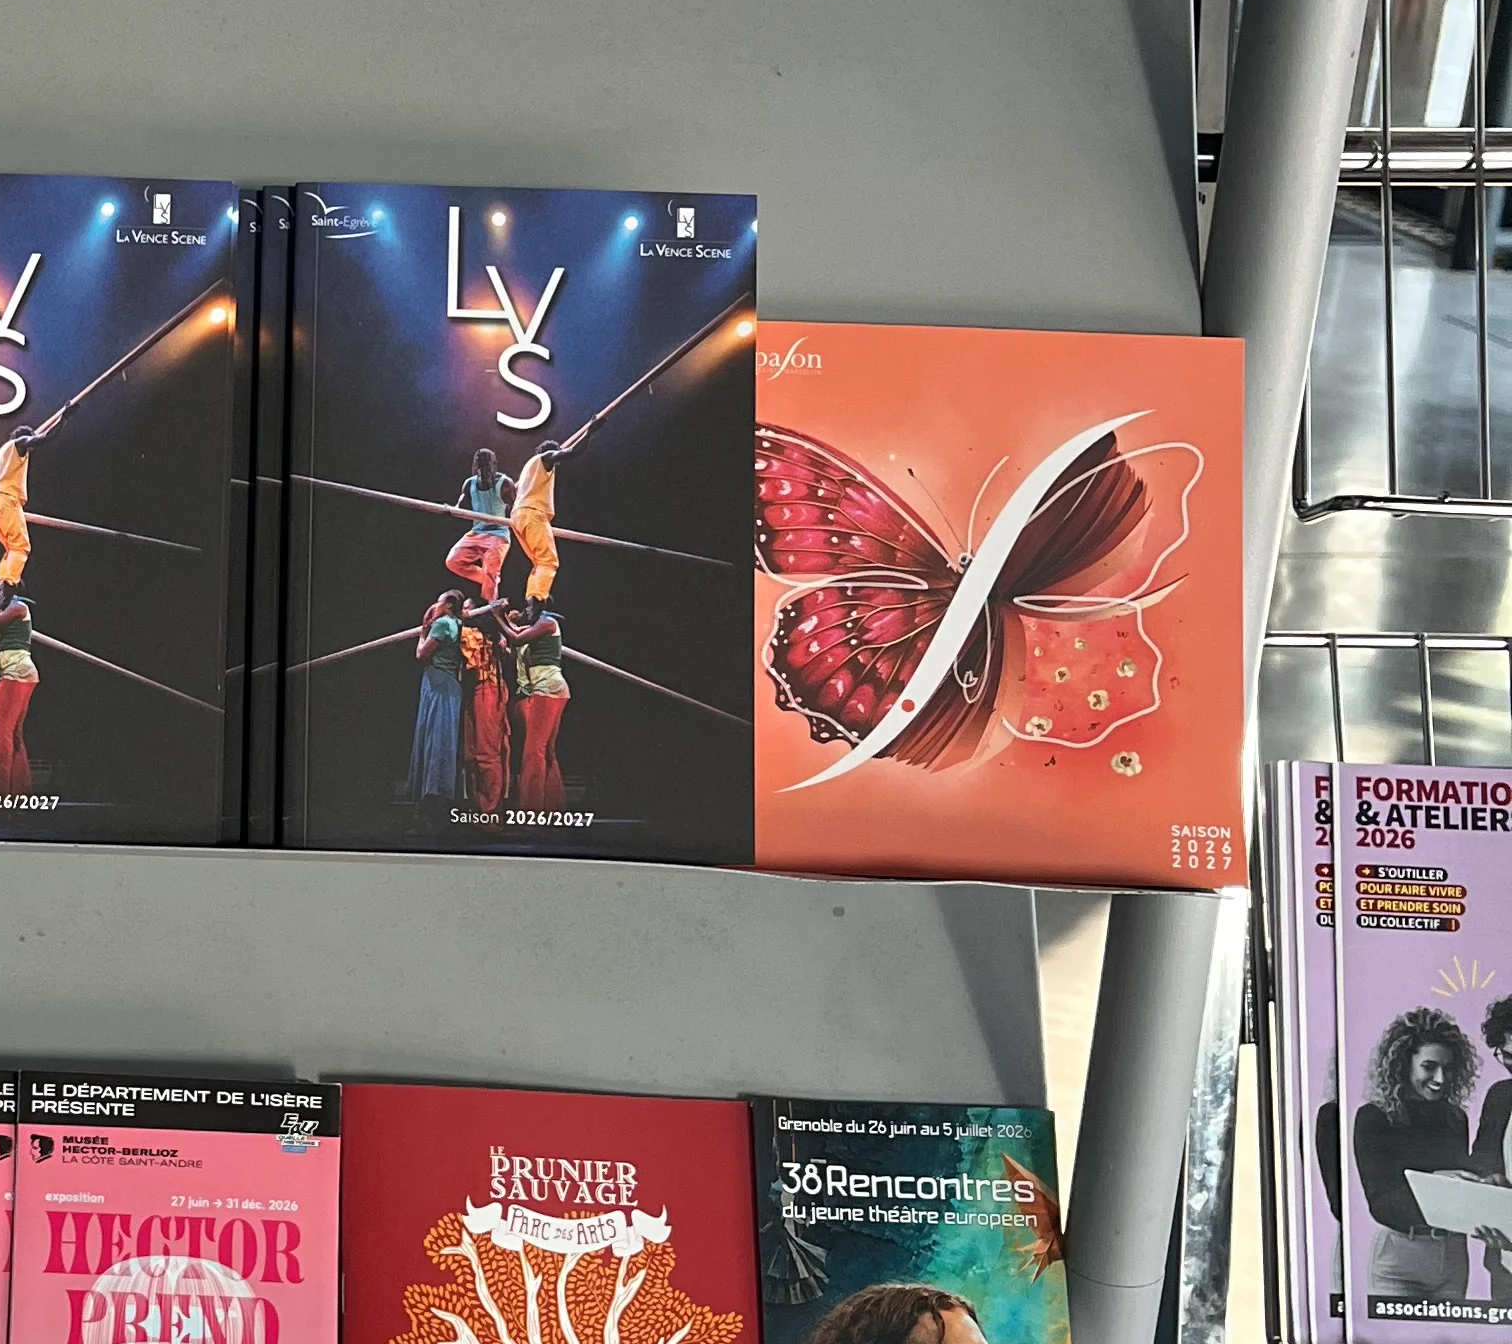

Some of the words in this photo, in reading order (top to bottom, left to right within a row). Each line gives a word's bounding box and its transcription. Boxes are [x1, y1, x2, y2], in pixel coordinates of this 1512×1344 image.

[1171, 825, 1231, 838] SAISON
[1356, 827, 1415, 849] 2026
[1378, 867, 1444, 881] S'OUTILLER
[1360, 882, 1392, 894] POUR
[1395, 883, 1427, 896] FAIRE
[1428, 886, 1462, 898] VIVRE
[1360, 900, 1375, 911] ET
[1377, 900, 1430, 913] PRENDRE
[1432, 901, 1461, 914] SOIN
[1360, 916, 1378, 927] DU
[1380, 917, 1440, 930] COLLECTIF
[32, 1083, 55, 1098] LE
[63, 1083, 210, 1104] DÉPARTEMENT
[217, 1091, 244, 1105] DE
[251, 1092, 322, 1109] L'ISÈRE
[31, 1099, 135, 1117] PRÉSENTE
[778, 1116, 843, 1133] Grenoble
[846, 1120, 865, 1133] du
[868, 1120, 887, 1135] 26
[889, 1121, 917, 1138] juin
[921, 1124, 940, 1136] au
[955, 1123, 992, 1140] juillet
[997, 1125, 1032, 1139] 2026
[63, 1135, 108, 1146] MUSÉE
[62, 1145, 178, 1157] HECTOR-BERLIOZ
[490, 1155, 637, 1186] PRUNIER
[490, 1176, 637, 1206] SAUVAGE
[827, 1165, 1035, 1203] Rencontres
[45, 1191, 105, 1205] exposition
[171, 1196, 185, 1207] 27
[187, 1195, 209, 1210] juin
[226, 1198, 239, 1209] 31
[241, 1198, 266, 1211] déc.
[269, 1199, 298, 1212] 2026
[783, 1202, 806, 1219] du
[810, 1204, 863, 1225] jeune
[869, 1204, 938, 1224] théâtre
[43, 1210, 305, 1284] HECTOR
